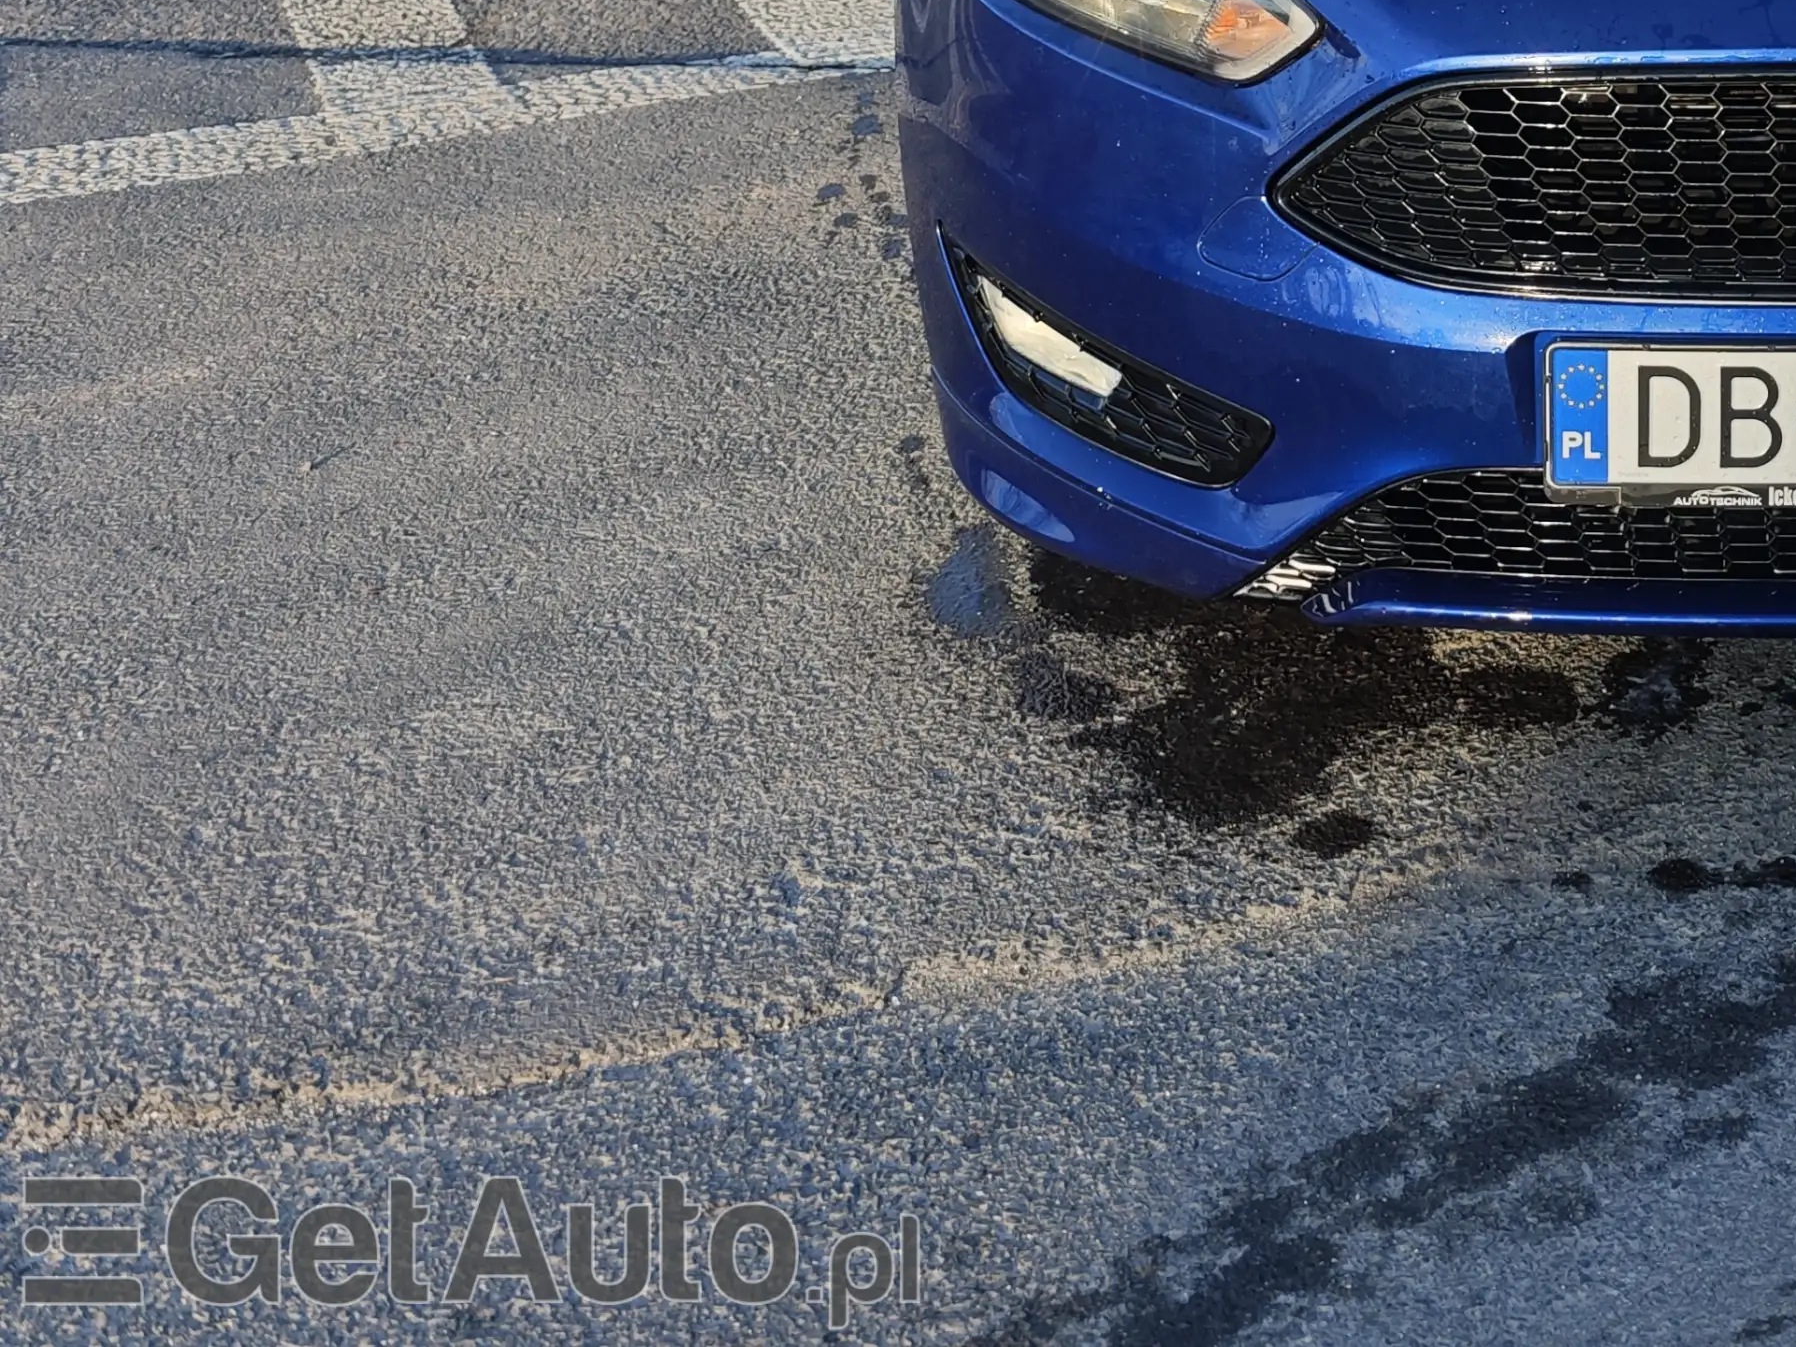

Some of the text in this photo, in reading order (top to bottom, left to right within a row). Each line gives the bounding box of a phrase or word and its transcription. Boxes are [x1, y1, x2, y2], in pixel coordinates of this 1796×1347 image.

[1637, 365, 1783, 468] DB
[1561, 431, 1602, 460] PL
[1672, 495, 1763, 506] AUTOTECHNIK
